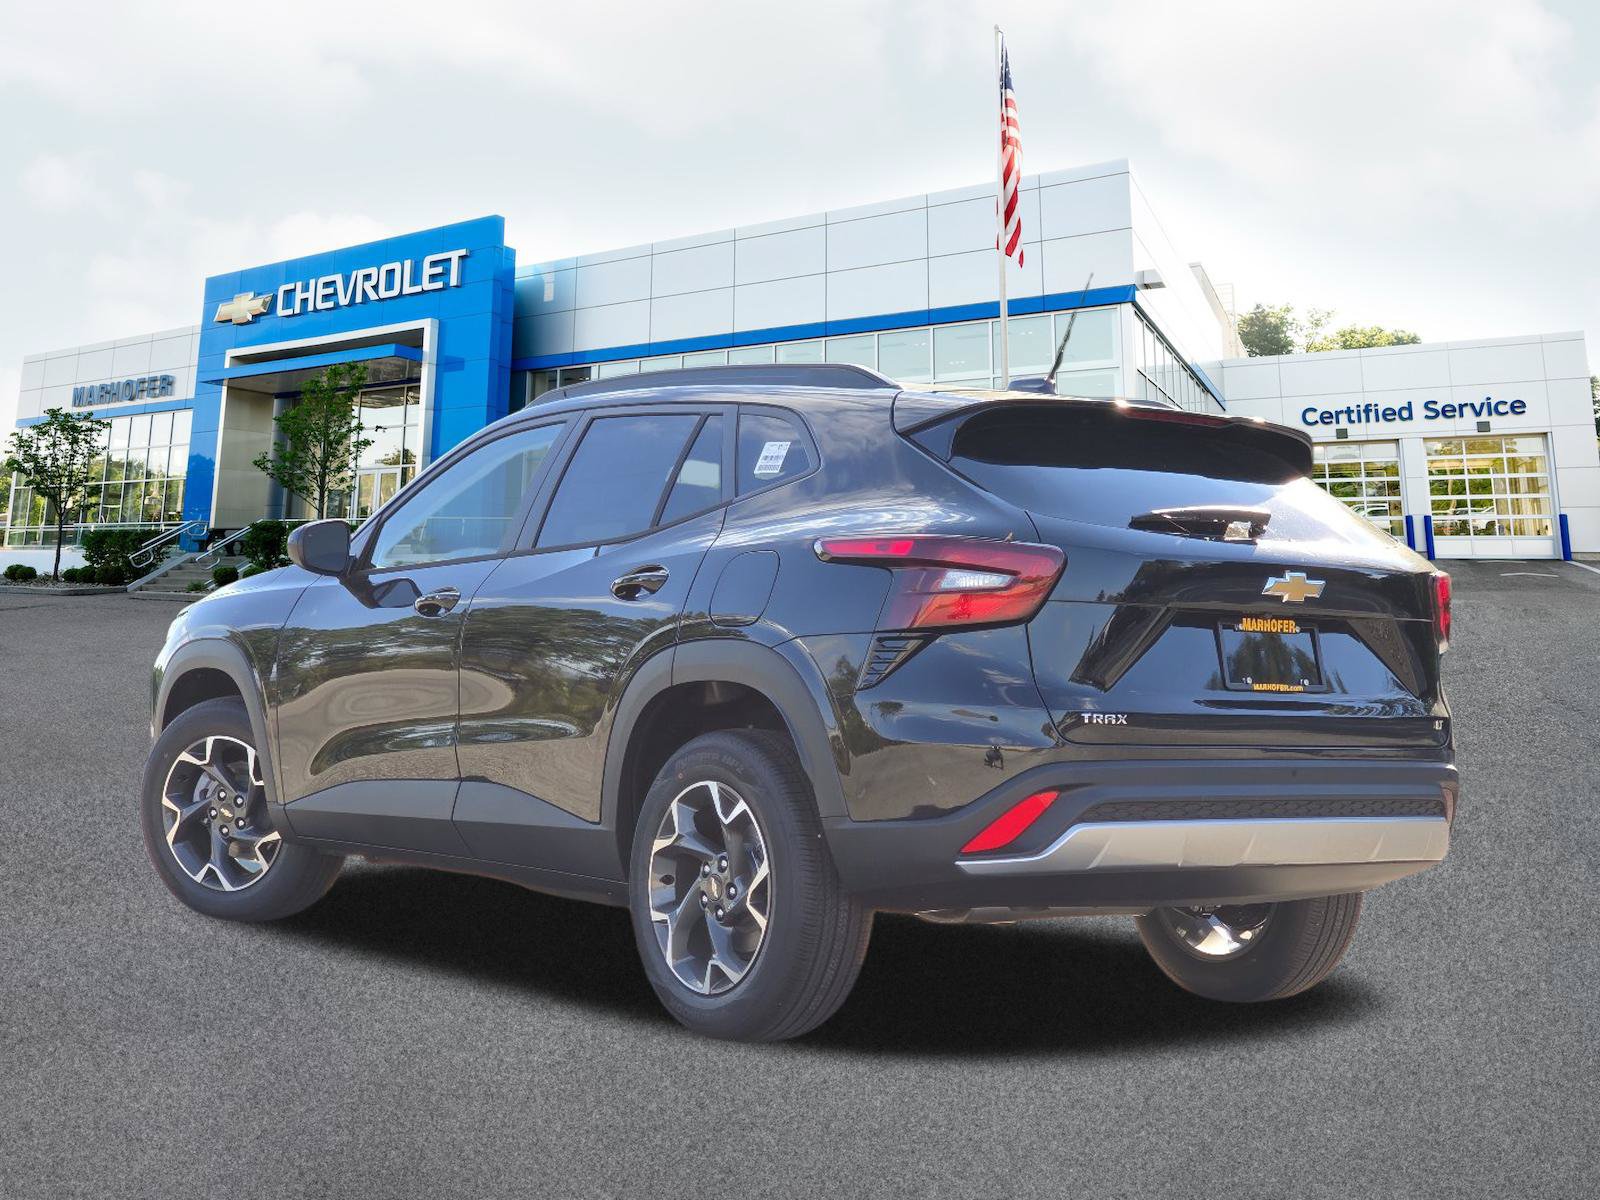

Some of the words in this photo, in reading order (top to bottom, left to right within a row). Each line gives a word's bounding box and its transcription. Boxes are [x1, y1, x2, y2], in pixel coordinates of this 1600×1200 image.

[276, 249, 469, 317] CHEVROLET
[72, 375, 175, 407] MARHOFER
[1302, 402, 1413, 426] Certified
[1424, 397, 1527, 420] Service
[1242, 618, 1296, 633] MARHOFER
[1081, 713, 1128, 725] TRAX
